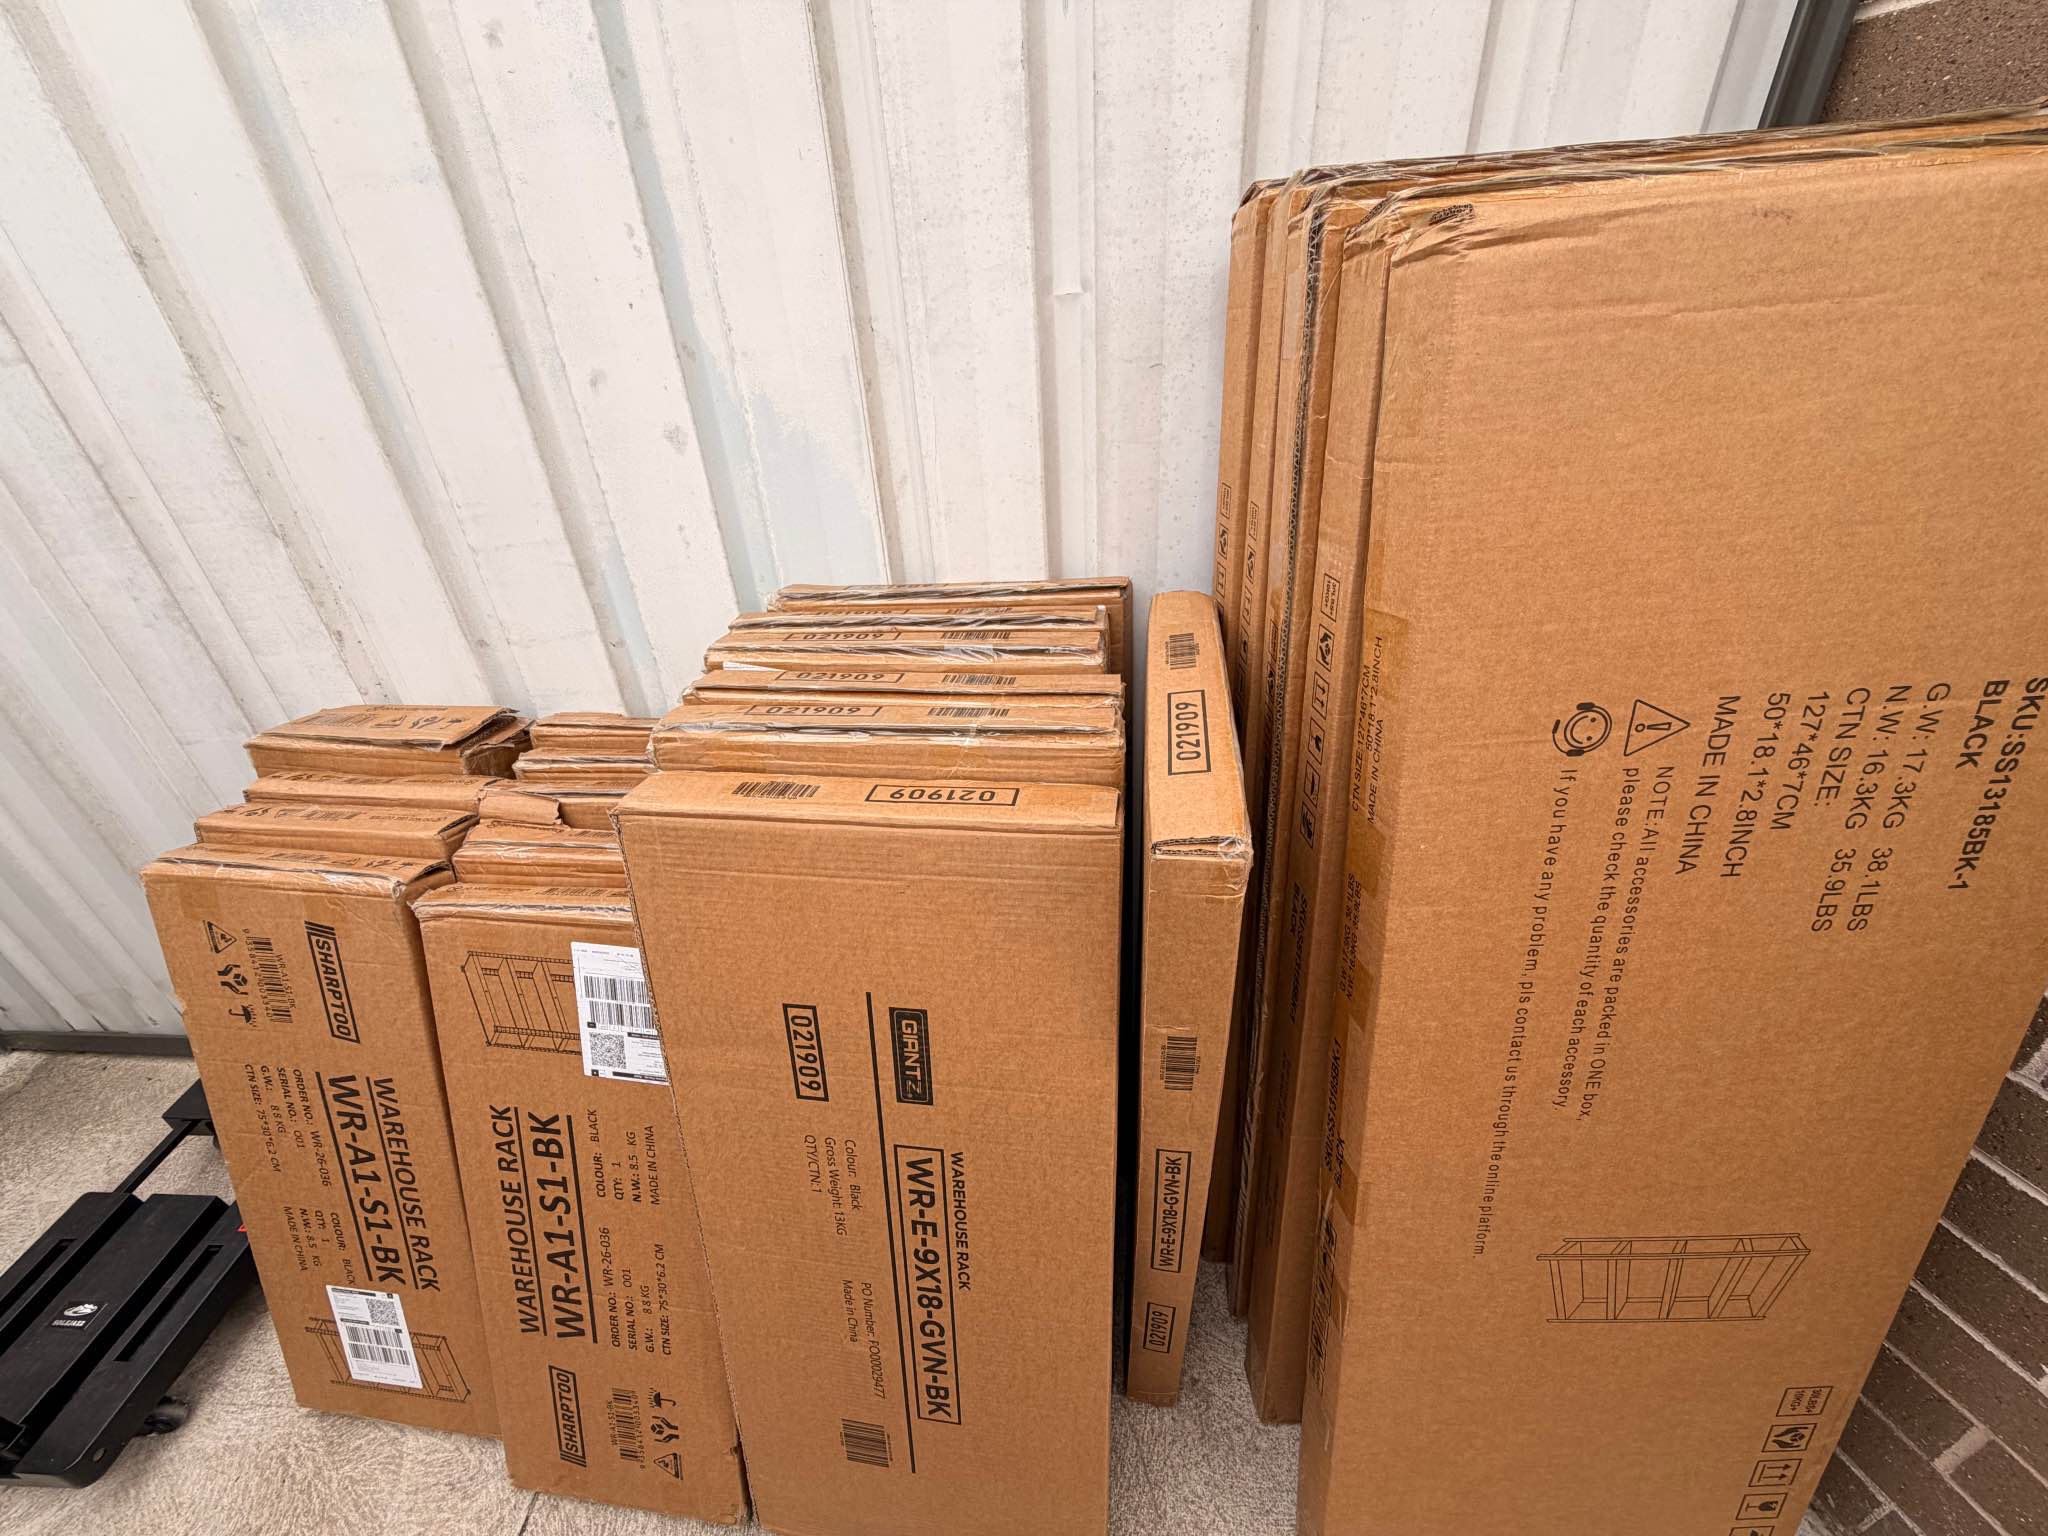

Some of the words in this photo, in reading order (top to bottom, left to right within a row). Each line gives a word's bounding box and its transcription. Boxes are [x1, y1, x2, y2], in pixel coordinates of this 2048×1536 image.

[796, 672, 886, 681] 021909
[766, 706, 862, 715] 021909
[1834, 687, 1871, 740] CTN
[1955, 680, 2010, 769] BLACK
[1175, 702, 1202, 761] 021909
[1374, 719, 1384, 763] CHINA
[1702, 696, 1741, 767] MADE
[1371, 765, 1379, 782] IN
[1560, 769, 1578, 782] If
[1694, 775, 1721, 797] IN
[1814, 747, 1853, 807] SIZE:
[1845, 749, 1889, 830] 16.3KG
[1882, 748, 1928, 829] 17.3KG
[1948, 677, 2048, 889] SKU:SS13185BK-1
[889, 787, 996, 801] 021909
[1353, 785, 1361, 812] CTN
[1367, 784, 1378, 824] MADE
[1552, 786, 1569, 819] you
[1615, 767, 1641, 827] please
[1543, 823, 1567, 866] have
[1603, 831, 1627, 882] check
[1674, 804, 1712, 875] CHINA
[1534, 871, 1555, 901] any
[1597, 886, 1617, 911] the
[1812, 848, 1856, 932] 35.9LBS
[1847, 848, 1893, 932] 38.1LBS
[1616, 856, 1649, 954] accessories
[1521, 905, 1547, 977] problem,
[1579, 915, 1607, 978] quantity
[315, 938, 352, 1037] SHARPTOO
[1609, 958, 1626, 983] are
[1518, 981, 1535, 1004] pls
[1579, 982, 1594, 997] of
[1570, 999, 1589, 1035] each
[1597, 987, 1619, 1038] packed
[790, 1014, 822, 1091] 021909
[1509, 1008, 1528, 1062] contact
[1593, 1041, 1610, 1055] in
[901, 1019, 922, 1097] GIANTZ
[1504, 1065, 1518, 1082] us
[1552, 1038, 1580, 1110] accessory.
[1586, 1058, 1606, 1090] ONE
[245, 1063, 255, 1083] CTN
[251, 1083, 262, 1106] SIZE:
[271, 1158, 281, 1173] CM
[261, 1065, 272, 1091] G.W.:
[277, 1122, 287, 1134] KG
[277, 1067, 293, 1101] SERIAL
[286, 1101, 298, 1123] NO.:
[294, 1130, 305, 1150] 001
[1492, 1085, 1516, 1138] through
[1576, 1093, 1598, 1121] box,
[293, 1069, 309, 1102] ORDER
[304, 1102, 315, 1126] NO.:
[311, 1130, 332, 1187] WR-26-036
[489, 1104, 519, 1173] RACK
[587, 1109, 600, 1143] BLACK
[626, 1131, 637, 1147] KG
[644, 1125, 656, 1159] CHINA
[611, 1161, 621, 1169] 1
[628, 1154, 639, 1171] 8.5
[648, 1161, 658, 1177] IN
[845, 1139, 857, 1178] Colour:
[1490, 1141, 1507, 1162] the
[328, 1075, 407, 1285] WR-A1-S1-BK
[374, 1078, 427, 1230] WAREHOUSE
[411, 1235, 441, 1292] RACK
[592, 1152, 607, 1199] COLOUR:
[612, 1177, 624, 1201] QTY:
[630, 1173, 642, 1203] N.W.:
[648, 1178, 660, 1205] MADE
[825, 1136, 837, 1169] Gross
[834, 1209, 847, 1236] 13KG
[1483, 1164, 1500, 1203] online
[850, 1184, 863, 1210] Black
[951, 1152, 969, 1248] WAREHOUSE
[1159, 1156, 1183, 1267] WR-E-9X18-GVN-BK
[283, 1205, 295, 1233] MADE
[300, 1208, 312, 1236] N.W.:
[306, 1235, 317, 1249] 8.5
[312, 1255, 322, 1267] KG
[315, 1210, 327, 1231] QTY:
[528, 1112, 586, 1338] WR-A1-S1-BK
[1473, 1206, 1494, 1259] platform.
[291, 1233, 300, 1244] IN
[330, 1211, 346, 1251] COLOUR:
[343, 1258, 356, 1285] BLACK
[501, 1180, 540, 1333] WAREHOUSE
[599, 1227, 614, 1287] WR-26-036
[654, 1241, 666, 1261] CM
[294, 1244, 308, 1272] CHINA
[956, 1251, 971, 1291] RACK
[622, 1268, 633, 1288] 001
[639, 1285, 650, 1299] KG
[842, 1279, 853, 1306] Made
[861, 1282, 872, 1296] PO
[906, 1157, 951, 1418] WR-E-9X18-GVN-BK
[607, 1291, 618, 1313] NO.:
[625, 1295, 636, 1318] NO.:
[846, 1308, 857, 1316] in
[610, 1313, 620, 1348] ORDER
[628, 1318, 638, 1351] SERIAL
[644, 1328, 655, 1353] G.W.:
[660, 1314, 671, 1336] SIZE:
[847, 1317, 858, 1343] China
[1149, 1311, 1169, 1347] 021909
[662, 1336, 672, 1356] CTN
[556, 1373, 579, 1453] SHARPTOO
